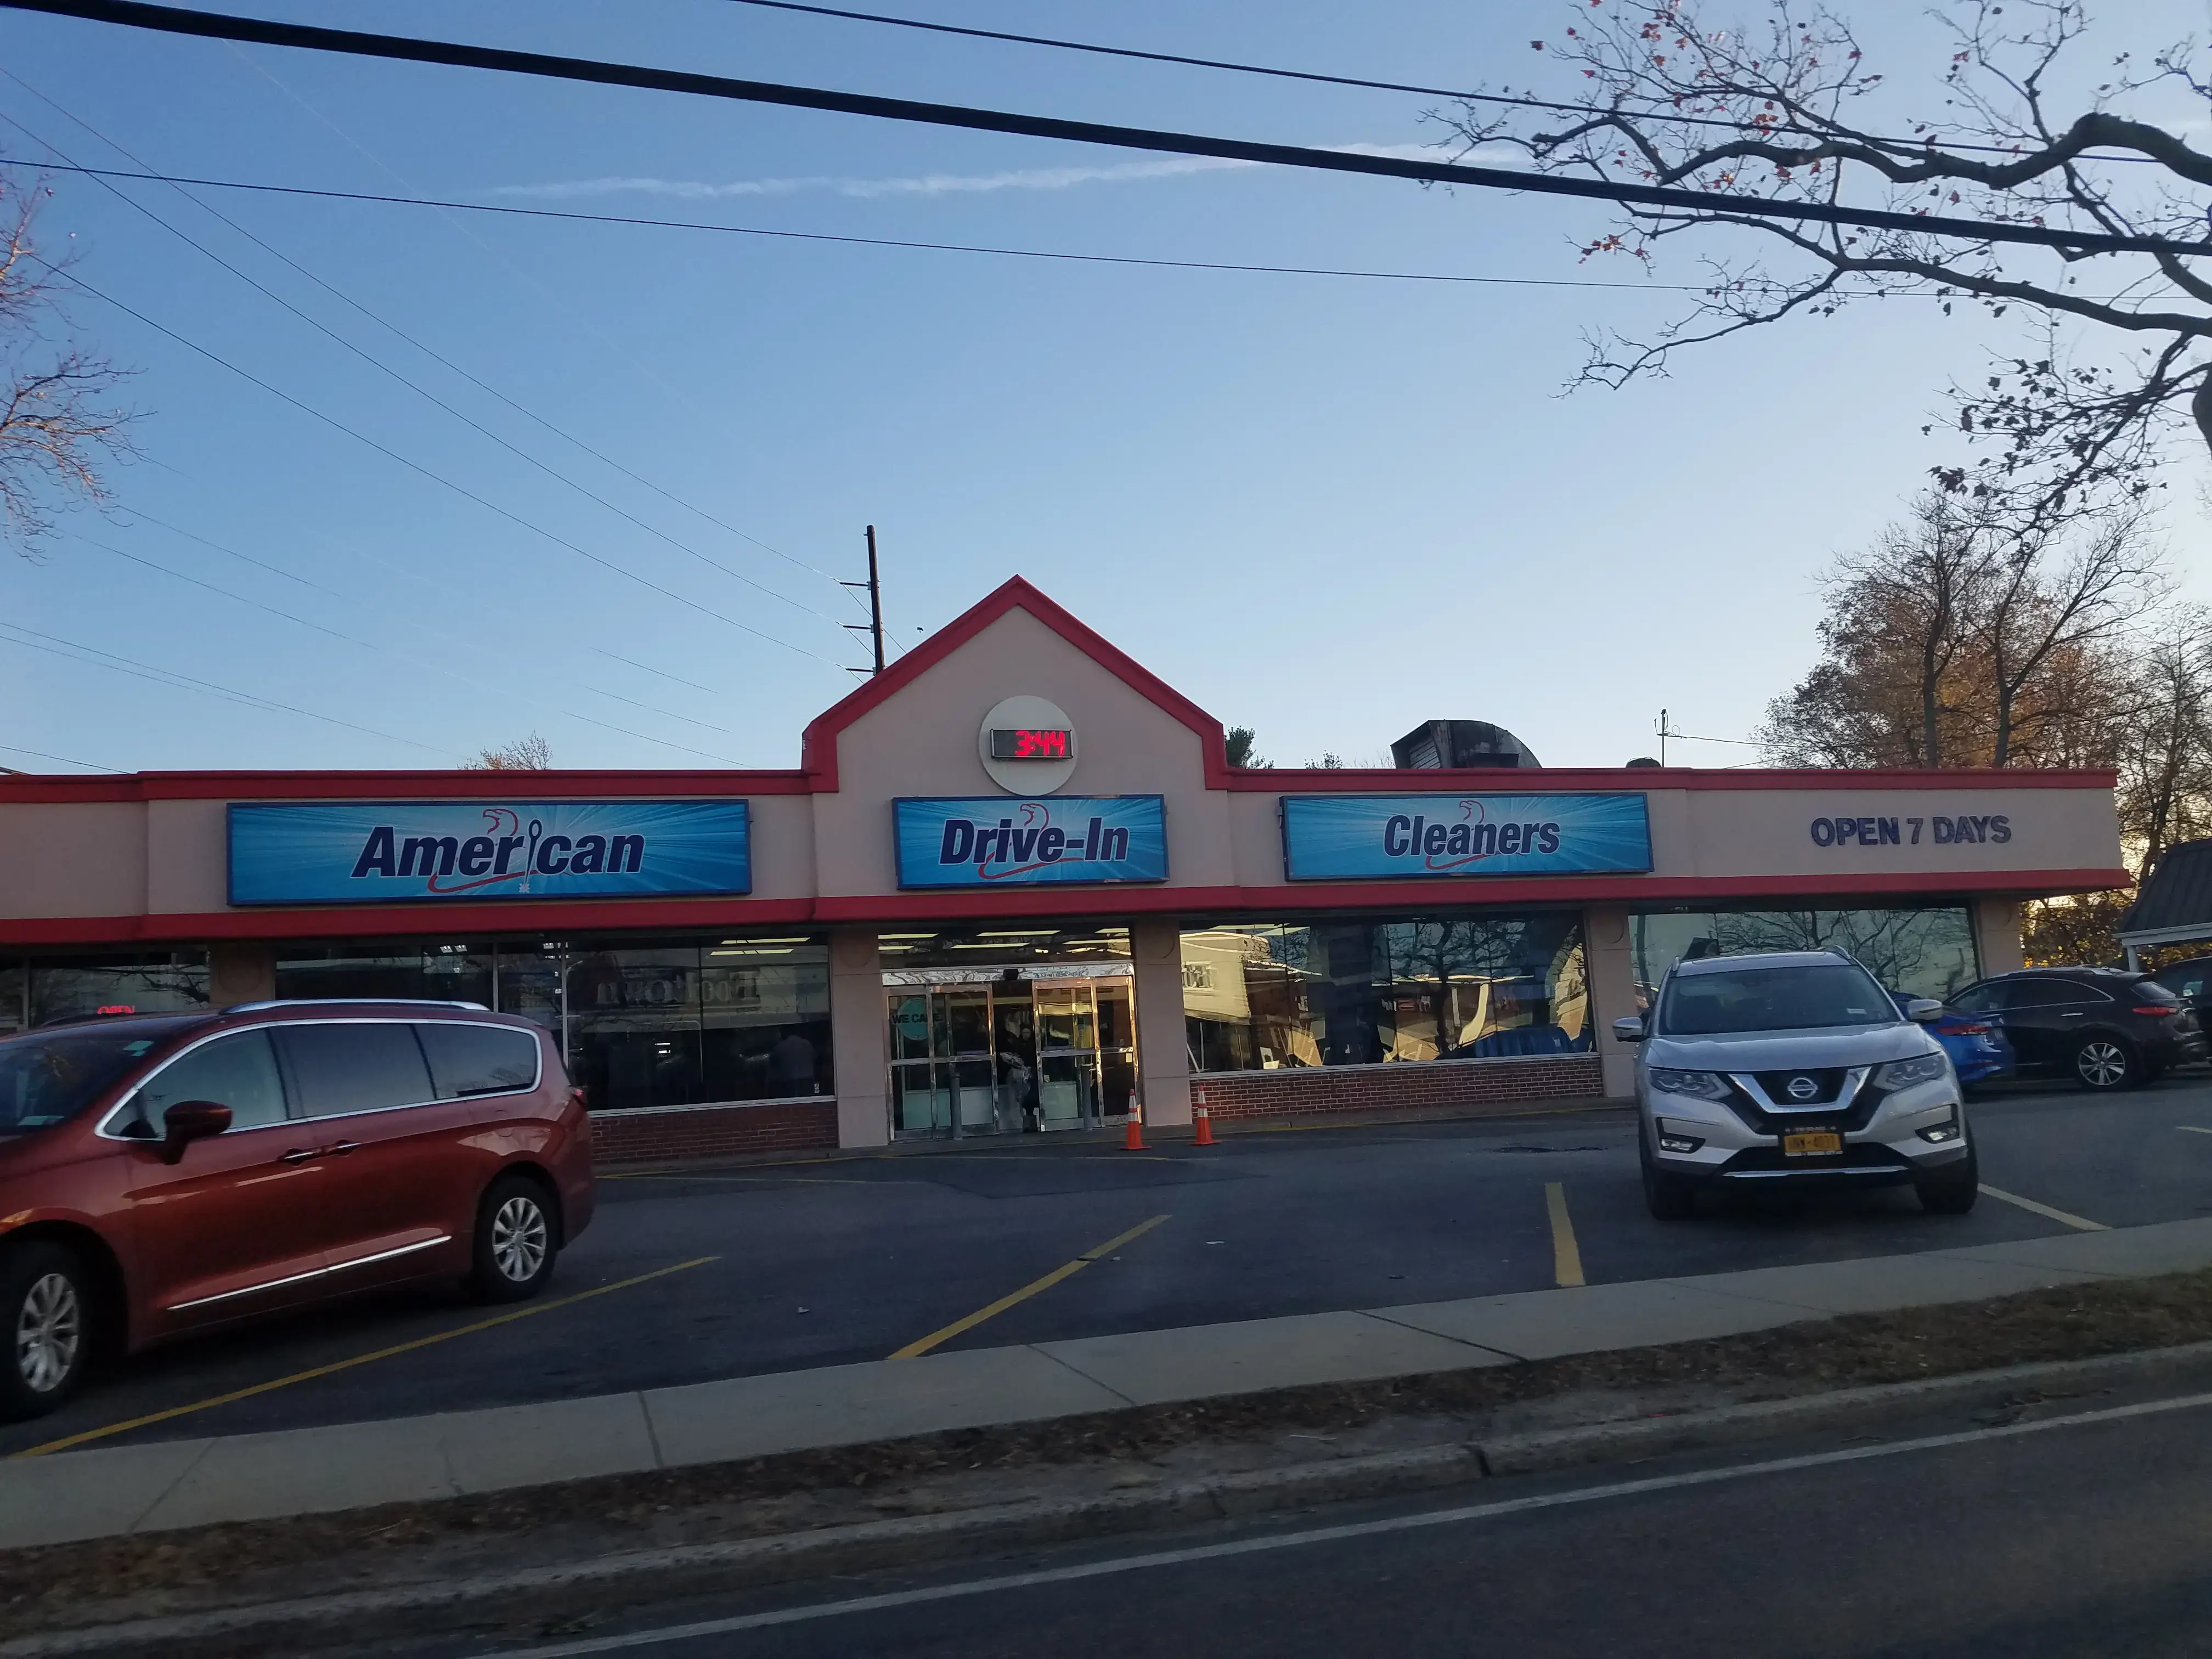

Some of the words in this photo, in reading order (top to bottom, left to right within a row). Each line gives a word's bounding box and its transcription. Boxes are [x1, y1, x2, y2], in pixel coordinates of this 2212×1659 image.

[1015, 730, 1065, 757] 3:44
[939, 816, 1130, 865] Drive-In
[1383, 814, 1561, 856] Cleaners
[1811, 817, 1900, 847] OPEN
[1906, 817, 1924, 844] 7
[1932, 815, 2012, 844] DAYS
[349, 820, 646, 880] American
[891, 1014, 910, 1024] WE
[912, 1013, 943, 1023] CAE
